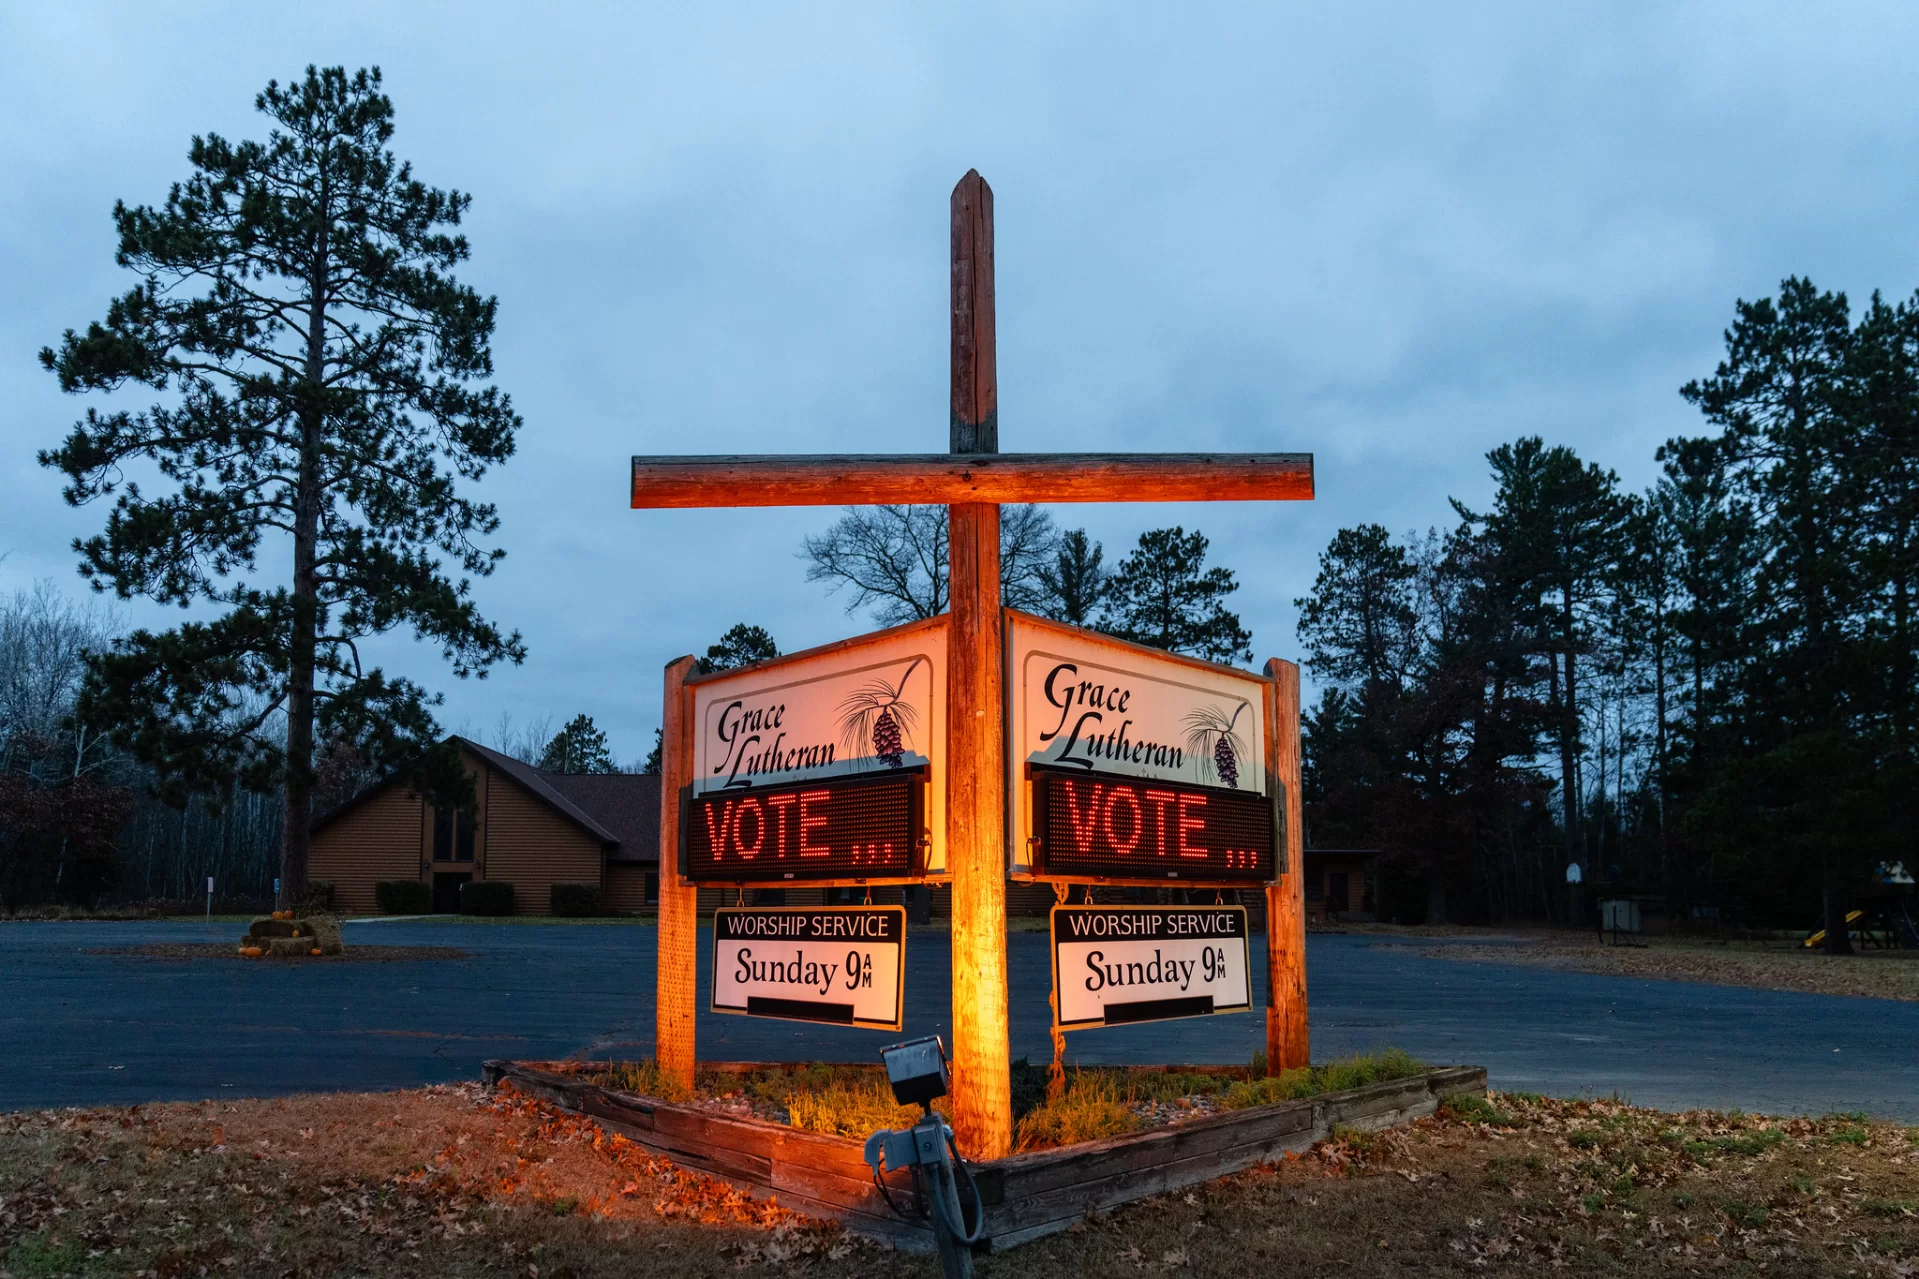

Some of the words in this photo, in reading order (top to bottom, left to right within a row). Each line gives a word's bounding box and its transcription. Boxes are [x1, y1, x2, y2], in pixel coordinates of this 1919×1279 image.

[1040, 663, 1131, 741] Grace
[714, 701, 786, 774] Grace
[722, 732, 836, 788] Lutheran
[1054, 712, 1184, 770] Lutheran
[705, 791, 831, 861] VOTE
[1065, 780, 1209, 858] VOTE
[727, 915, 807, 936] WORSHIP
[811, 915, 889, 937] SERVICE
[1069, 914, 1162, 936] WORSHIP
[1167, 914, 1236, 934] SERVICE
[735, 947, 839, 995] Sunday
[845, 951, 861, 990] 9
[1085, 949, 1196, 991] Sunday
[1202, 946, 1216, 983] 9
